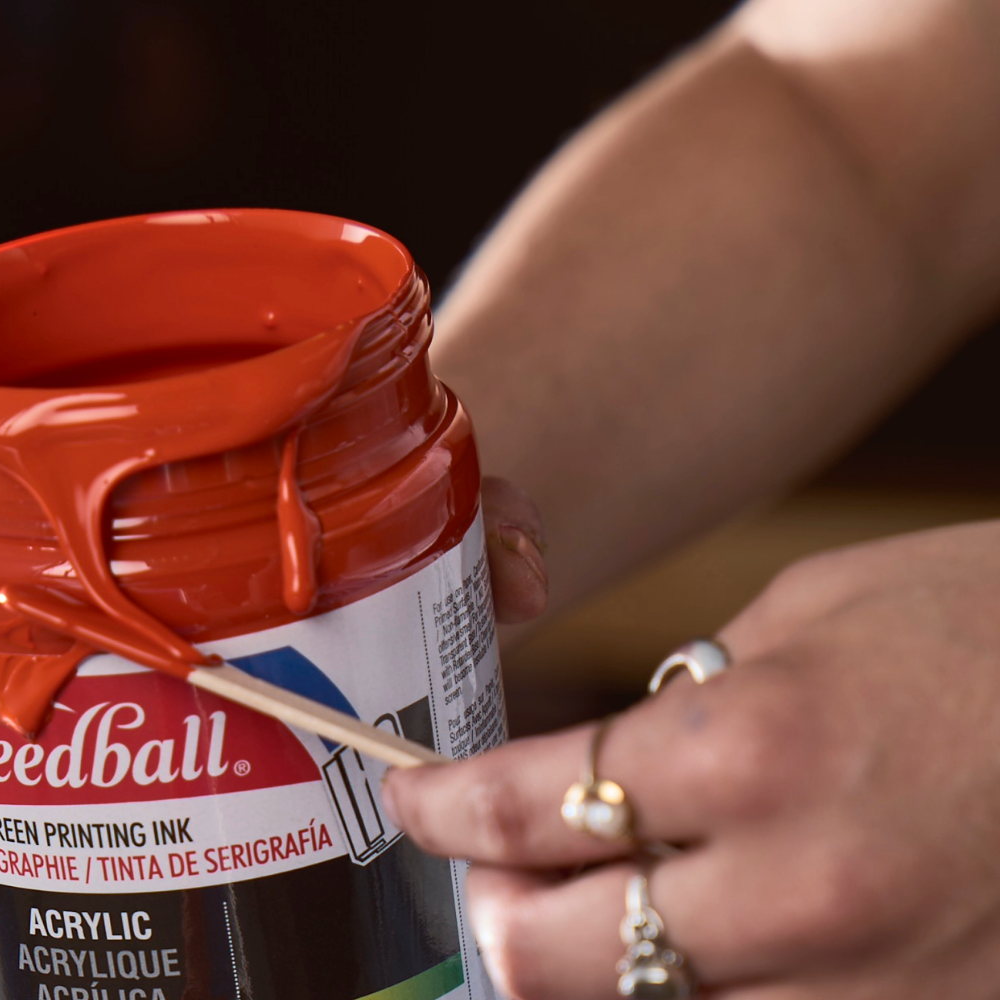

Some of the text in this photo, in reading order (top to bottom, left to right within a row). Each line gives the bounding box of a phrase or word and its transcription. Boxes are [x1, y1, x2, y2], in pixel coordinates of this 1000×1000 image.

[45, 821, 147, 848] PRINTING
[152, 817, 193, 845] INK
[96, 853, 164, 883] TINTA
[169, 849, 200, 879] DE
[205, 818, 333, 874] SERIGRAFÍA
[29, 907, 152, 940] ACRYLIC
[18, 943, 181, 981] ACRYLIQUE
